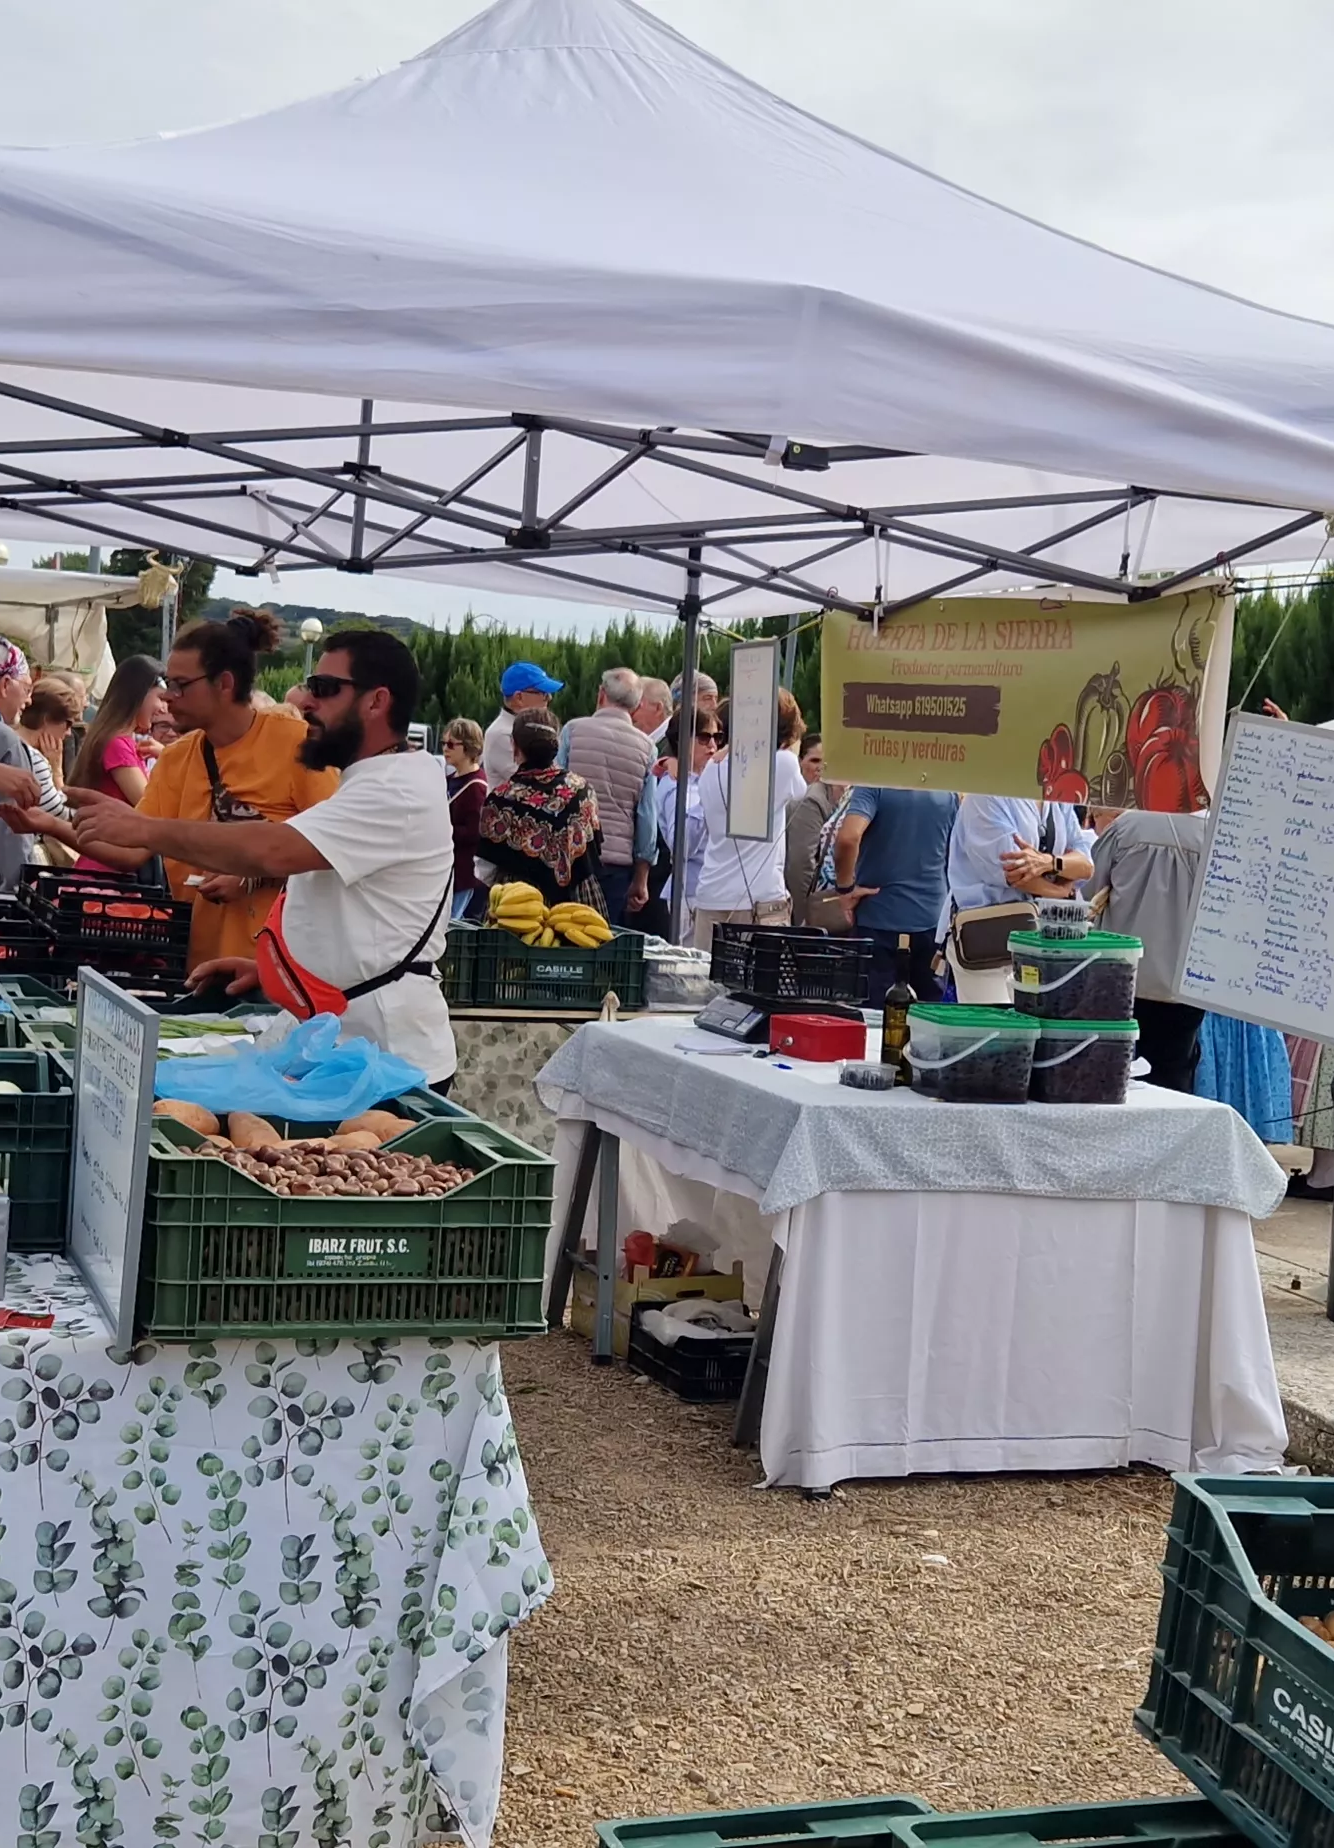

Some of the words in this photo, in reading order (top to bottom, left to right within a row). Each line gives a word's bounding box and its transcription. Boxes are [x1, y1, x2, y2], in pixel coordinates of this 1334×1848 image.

[847, 622, 927, 652] HUERTA
[929, 621, 961, 651] DE
[963, 620, 987, 651] LA
[993, 618, 1074, 651] SIERRA
[891, 657, 942, 678] Productor
[944, 659, 1024, 681] permacultura
[866, 694, 914, 720] Whatsapp
[914, 695, 967, 718] 619501525
[863, 733, 900, 756] Frutas
[900, 741, 911, 764] y
[911, 737, 967, 763] verduras
[308, 1238, 347, 1254] IBARZ
[349, 1238, 384, 1256] FRUT,
[386, 1238, 411, 1255] S.C.
